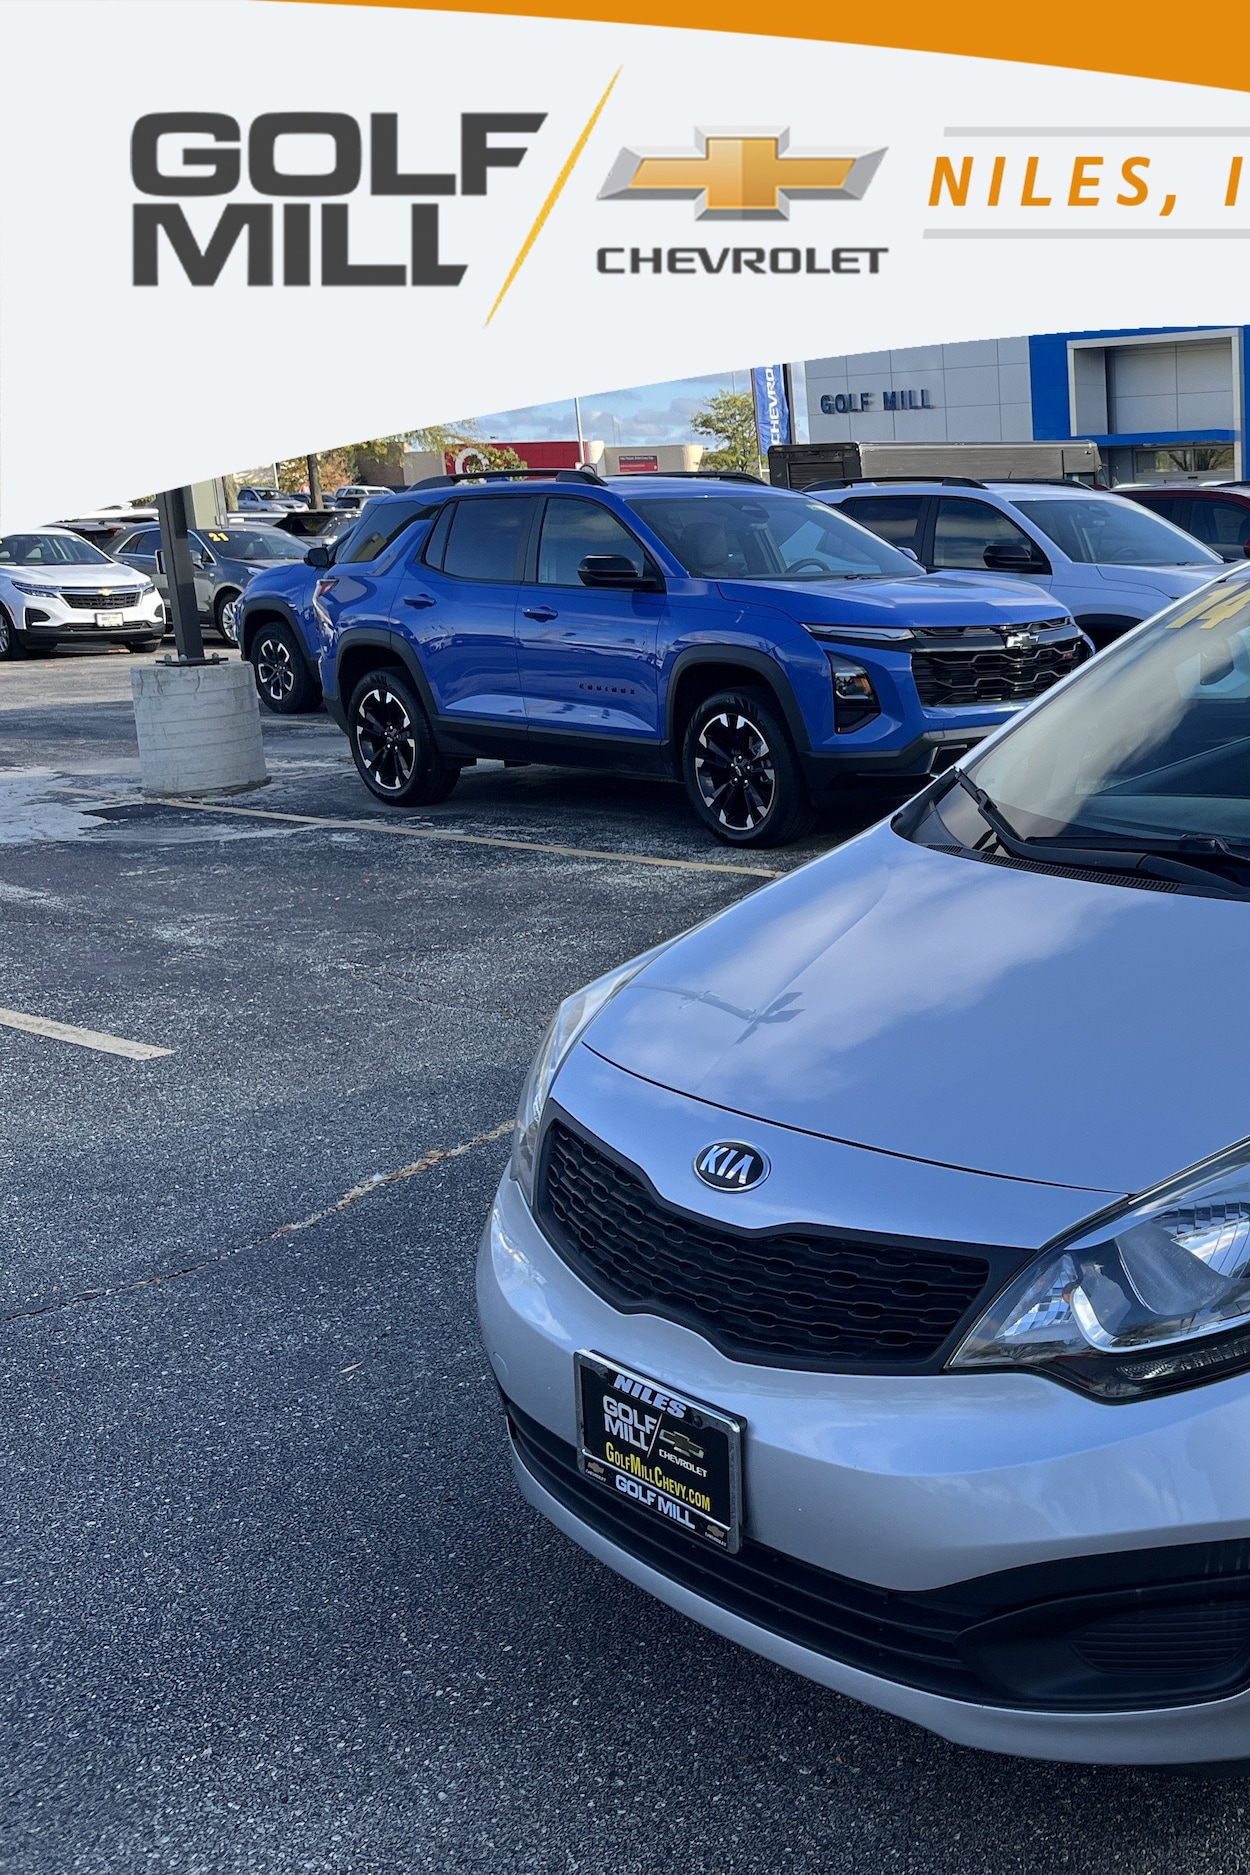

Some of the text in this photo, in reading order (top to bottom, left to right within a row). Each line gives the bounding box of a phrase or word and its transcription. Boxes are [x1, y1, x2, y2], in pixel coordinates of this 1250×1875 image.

[820, 389, 935, 415] GOLF MILL
[208, 532, 230, 542] 21
[699, 1144, 755, 1185] KIA
[602, 1394, 657, 1435] GOLF
[614, 1373, 687, 1419] NILES
[603, 1413, 651, 1452] MILL
[658, 1448, 708, 1478] CHEVROLET
[615, 1474, 696, 1530] GOLF MILL
